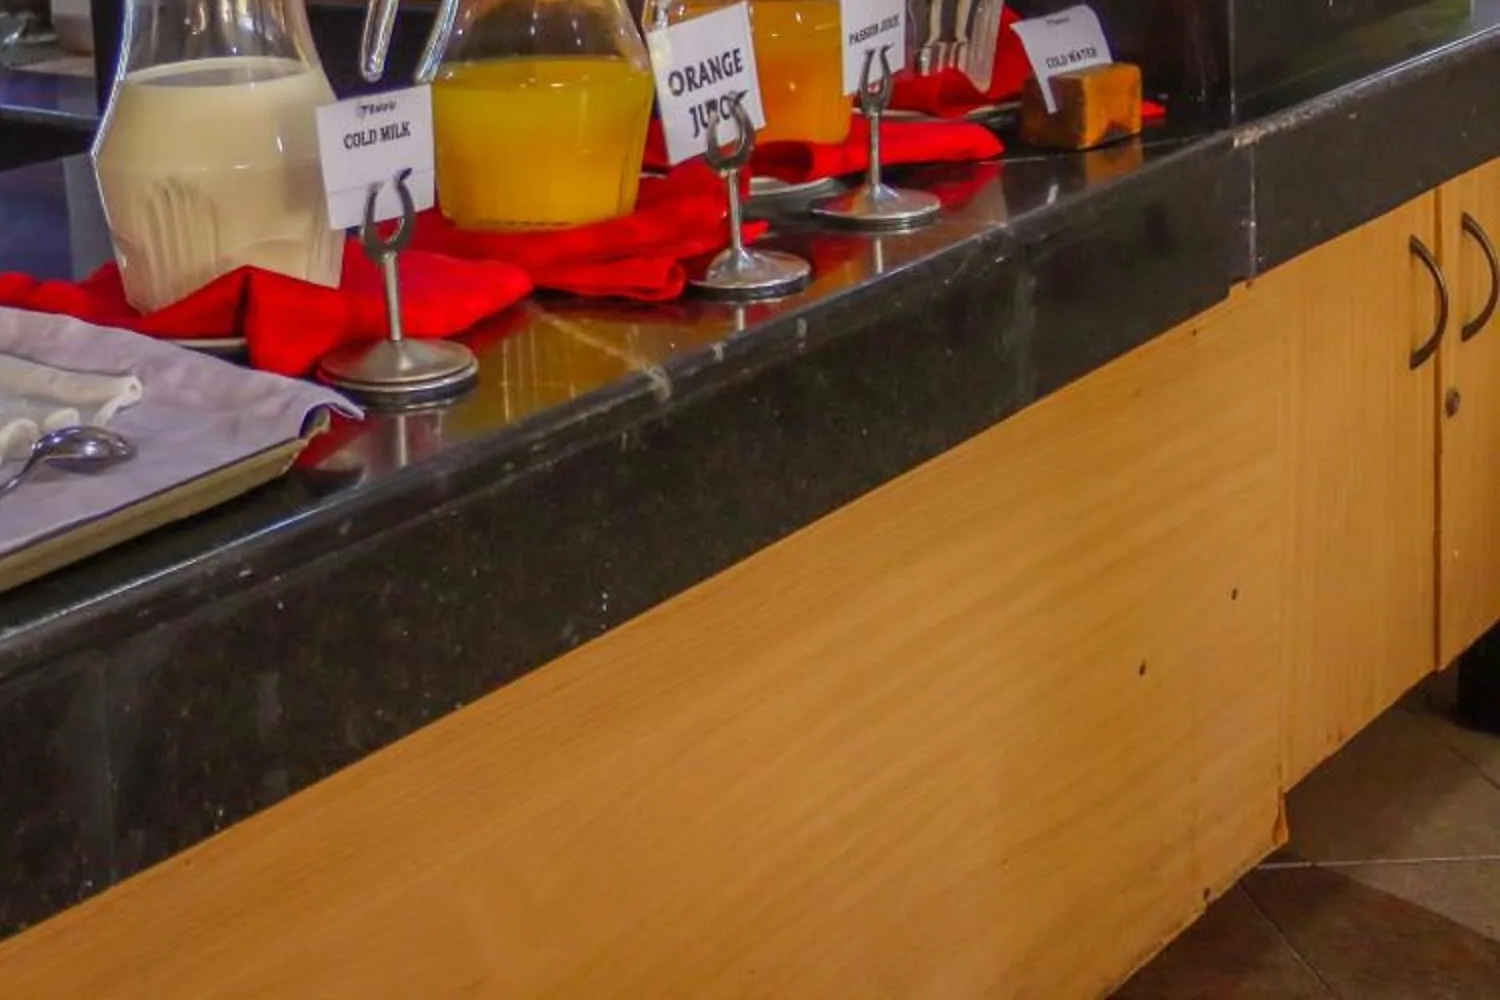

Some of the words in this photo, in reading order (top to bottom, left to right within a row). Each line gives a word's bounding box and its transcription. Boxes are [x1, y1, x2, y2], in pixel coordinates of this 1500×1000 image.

[668, 48, 743, 96] ORANGE
[343, 127, 377, 150] COLD
[380, 121, 412, 143] MILK
